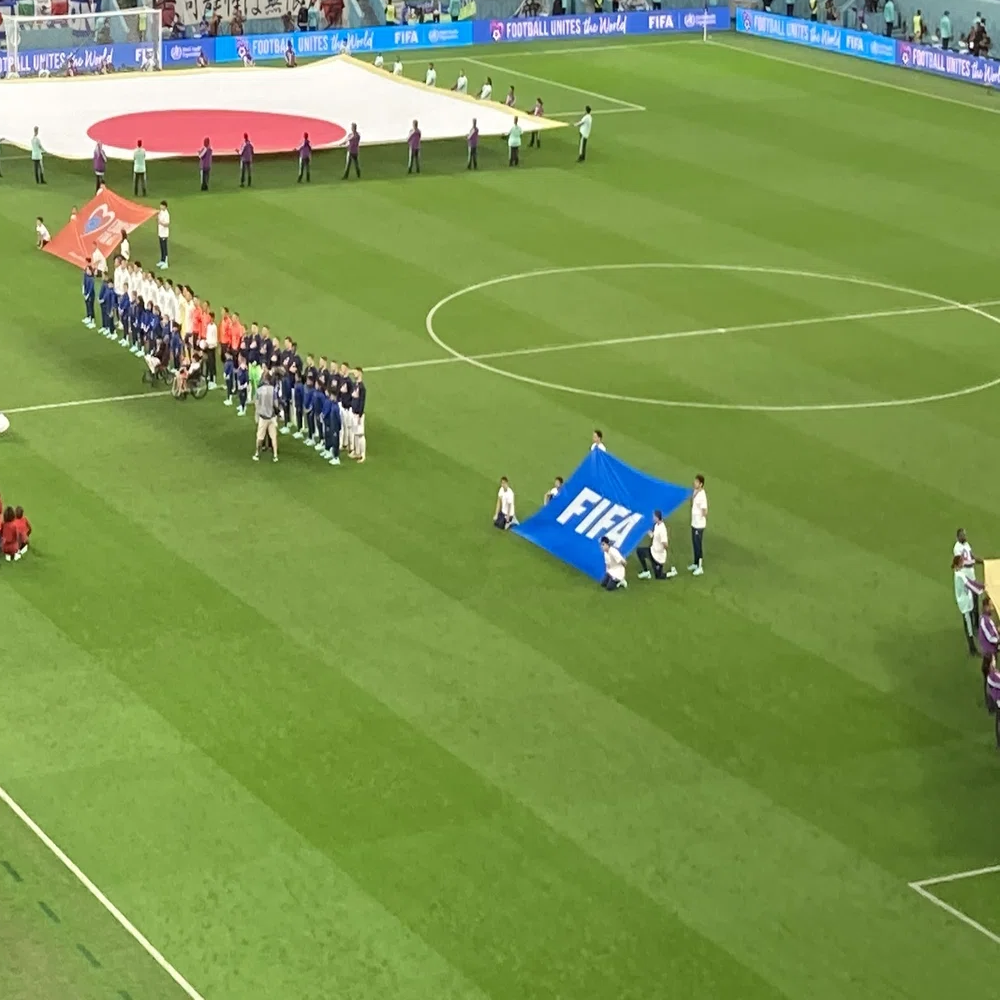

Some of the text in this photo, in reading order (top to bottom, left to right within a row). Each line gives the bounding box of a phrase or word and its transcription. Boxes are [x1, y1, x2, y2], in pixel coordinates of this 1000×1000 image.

[506, 14, 627, 38] FOOTBALL UNITES the World
[648, 14, 674, 29] FIFA
[298, 35, 328, 51] UNITES
[395, 30, 419, 45] FIFA
[846, 35, 864, 51] FIFA
[912, 48, 945, 72] FOOTBALL
[946, 55, 970, 77] UNITES
[556, 487, 645, 548] FIFA
